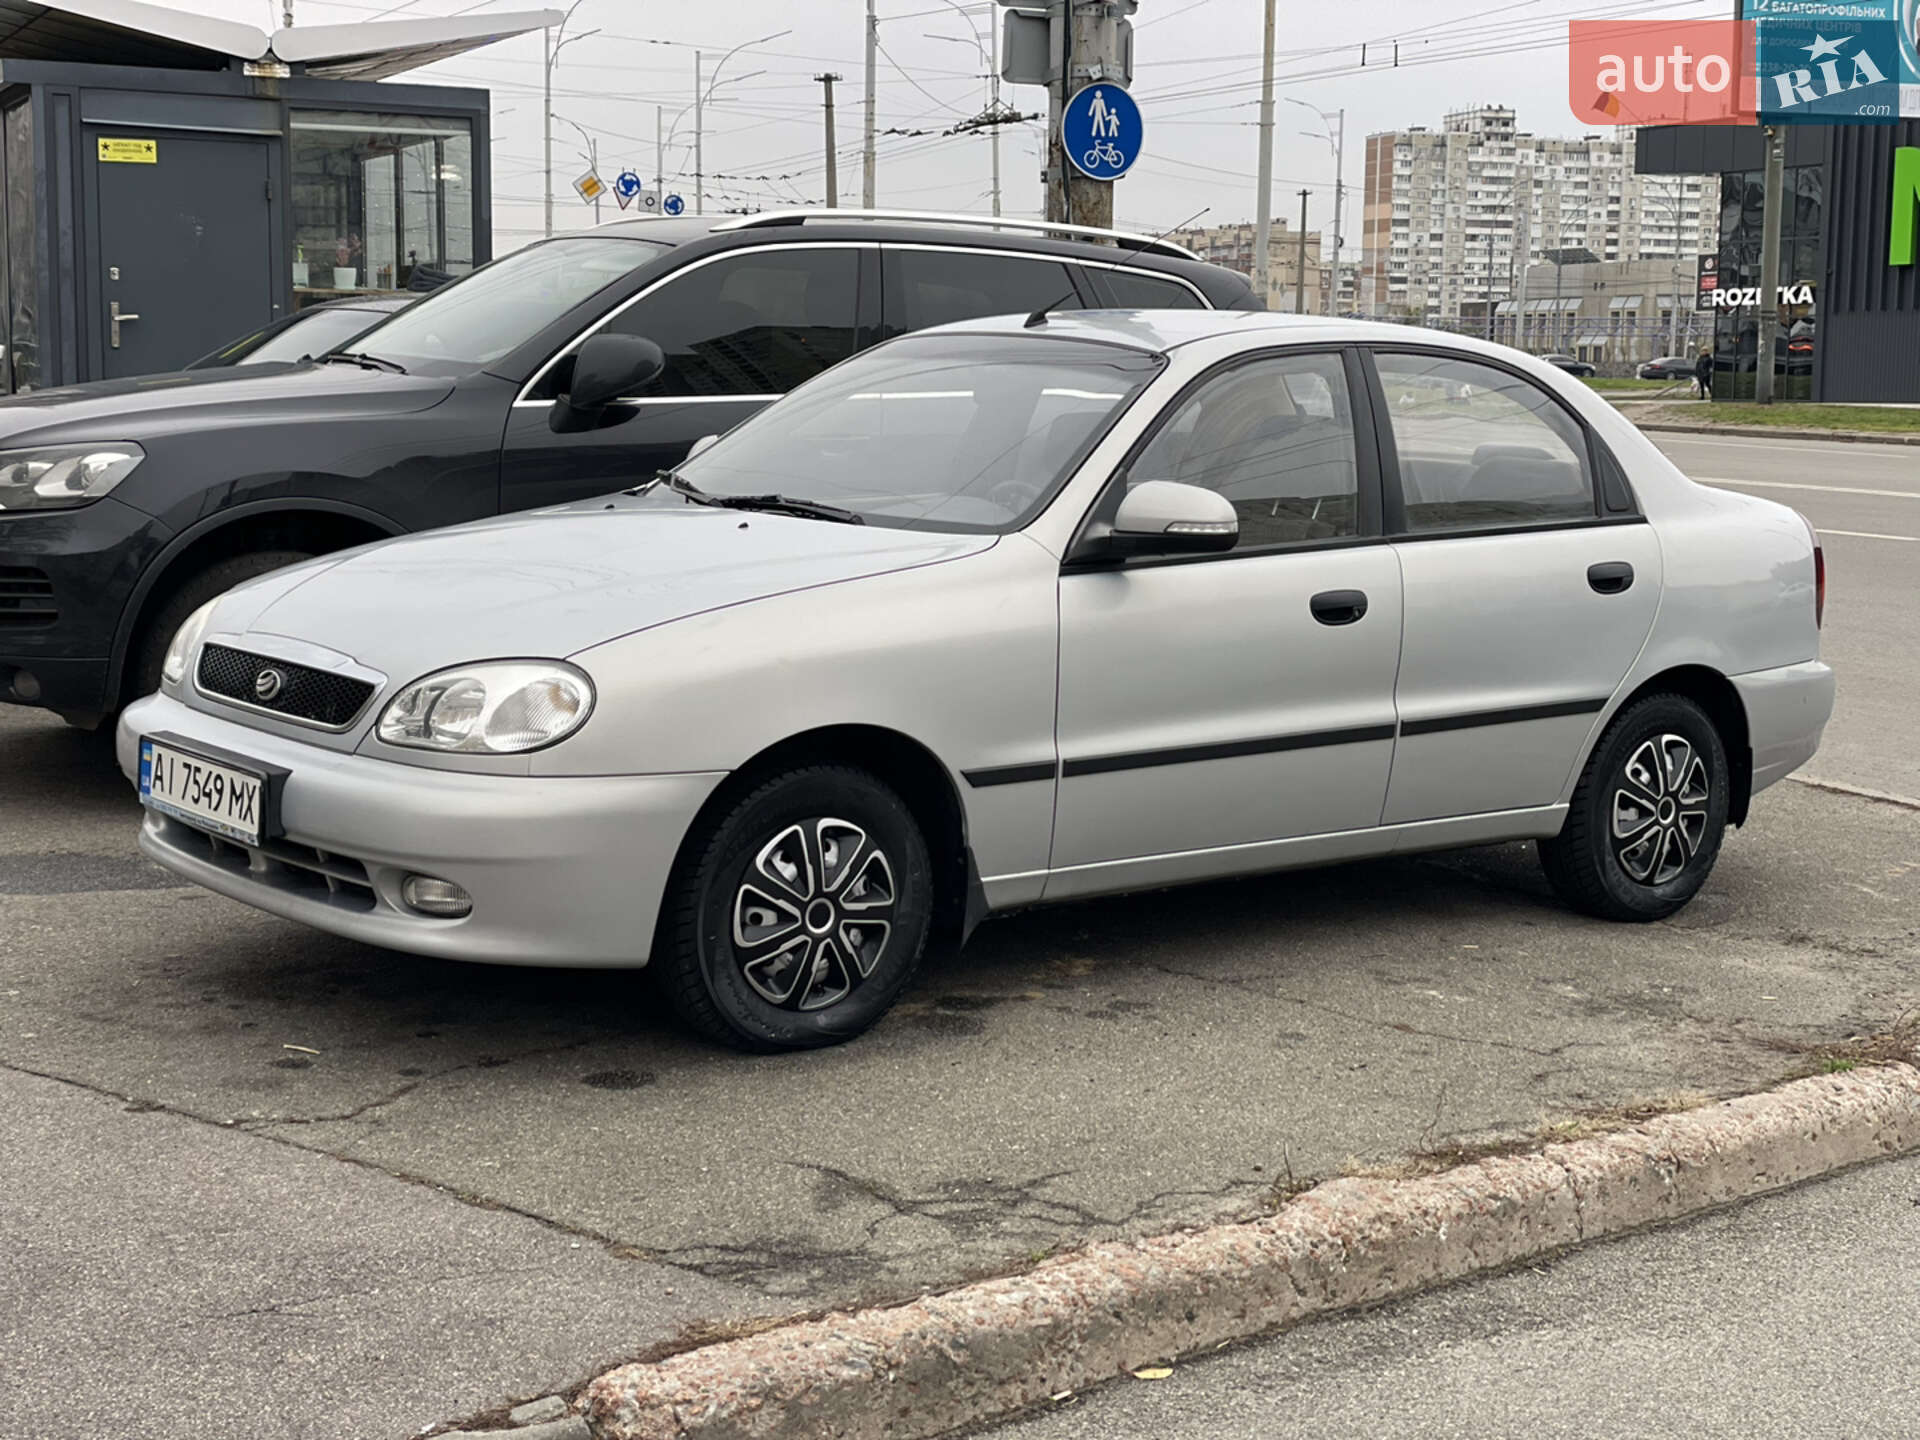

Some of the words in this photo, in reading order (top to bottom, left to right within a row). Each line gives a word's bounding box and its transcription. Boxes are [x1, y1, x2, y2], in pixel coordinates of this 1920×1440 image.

[1771, 2, 1886, 18] БАГАТОПРОФІЛЬНИХ
[1711, 285, 1814, 307] ROZKA
[152, 753, 174, 795] AI
[182, 762, 225, 812] 7549
[228, 777, 257, 825] MX
